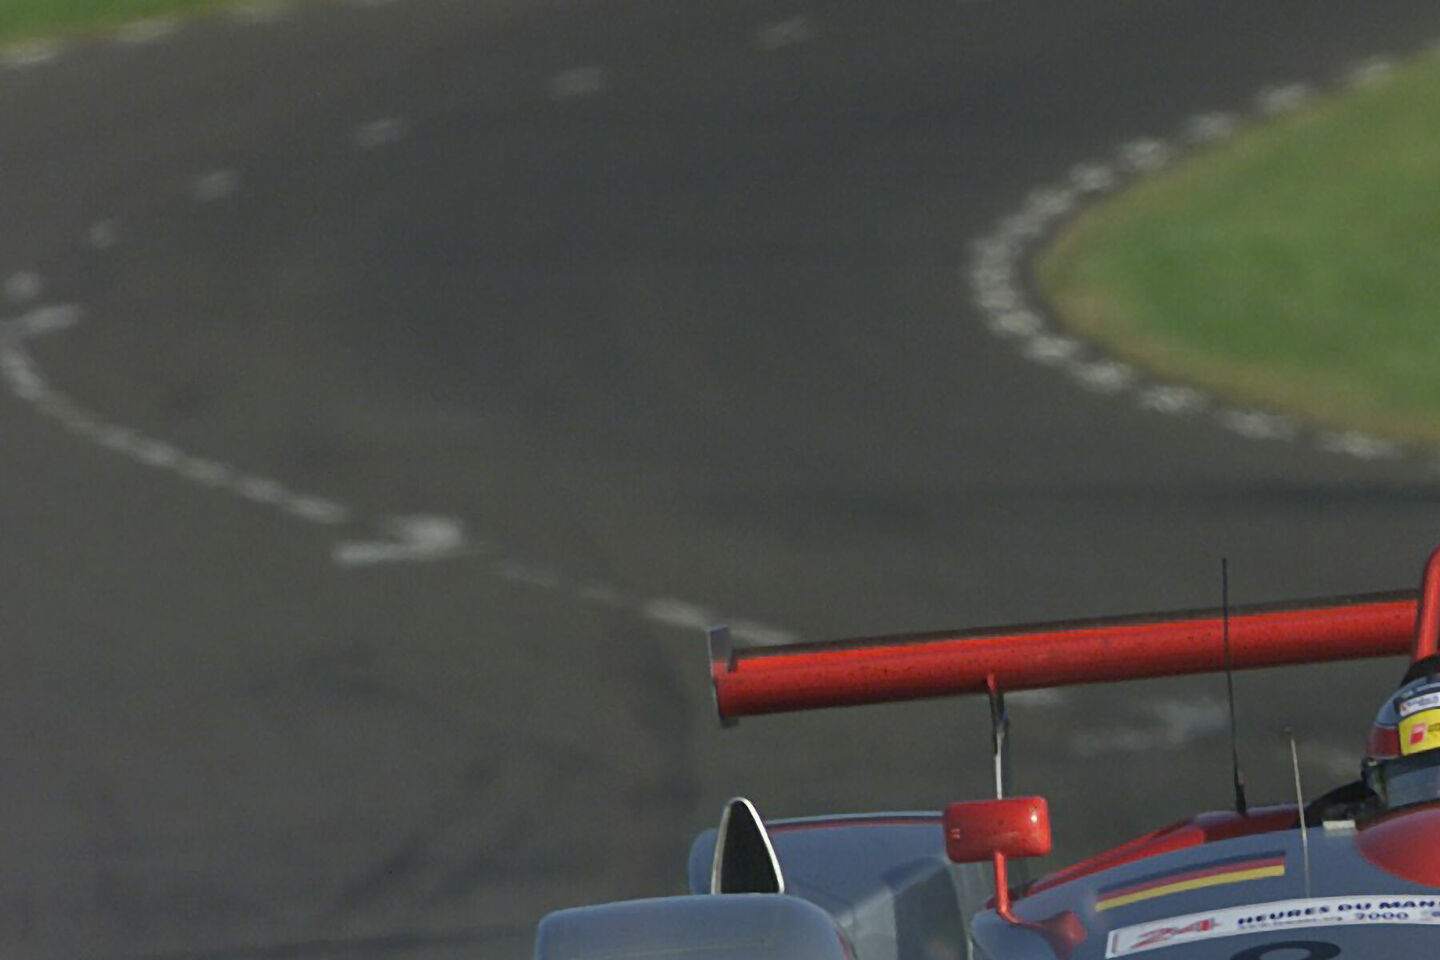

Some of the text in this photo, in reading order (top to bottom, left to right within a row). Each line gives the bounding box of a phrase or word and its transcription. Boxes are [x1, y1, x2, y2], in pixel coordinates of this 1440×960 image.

[1236, 905, 1331, 926] HEURES
[1337, 902, 1372, 912] DU
[1355, 911, 1409, 921] 2000
